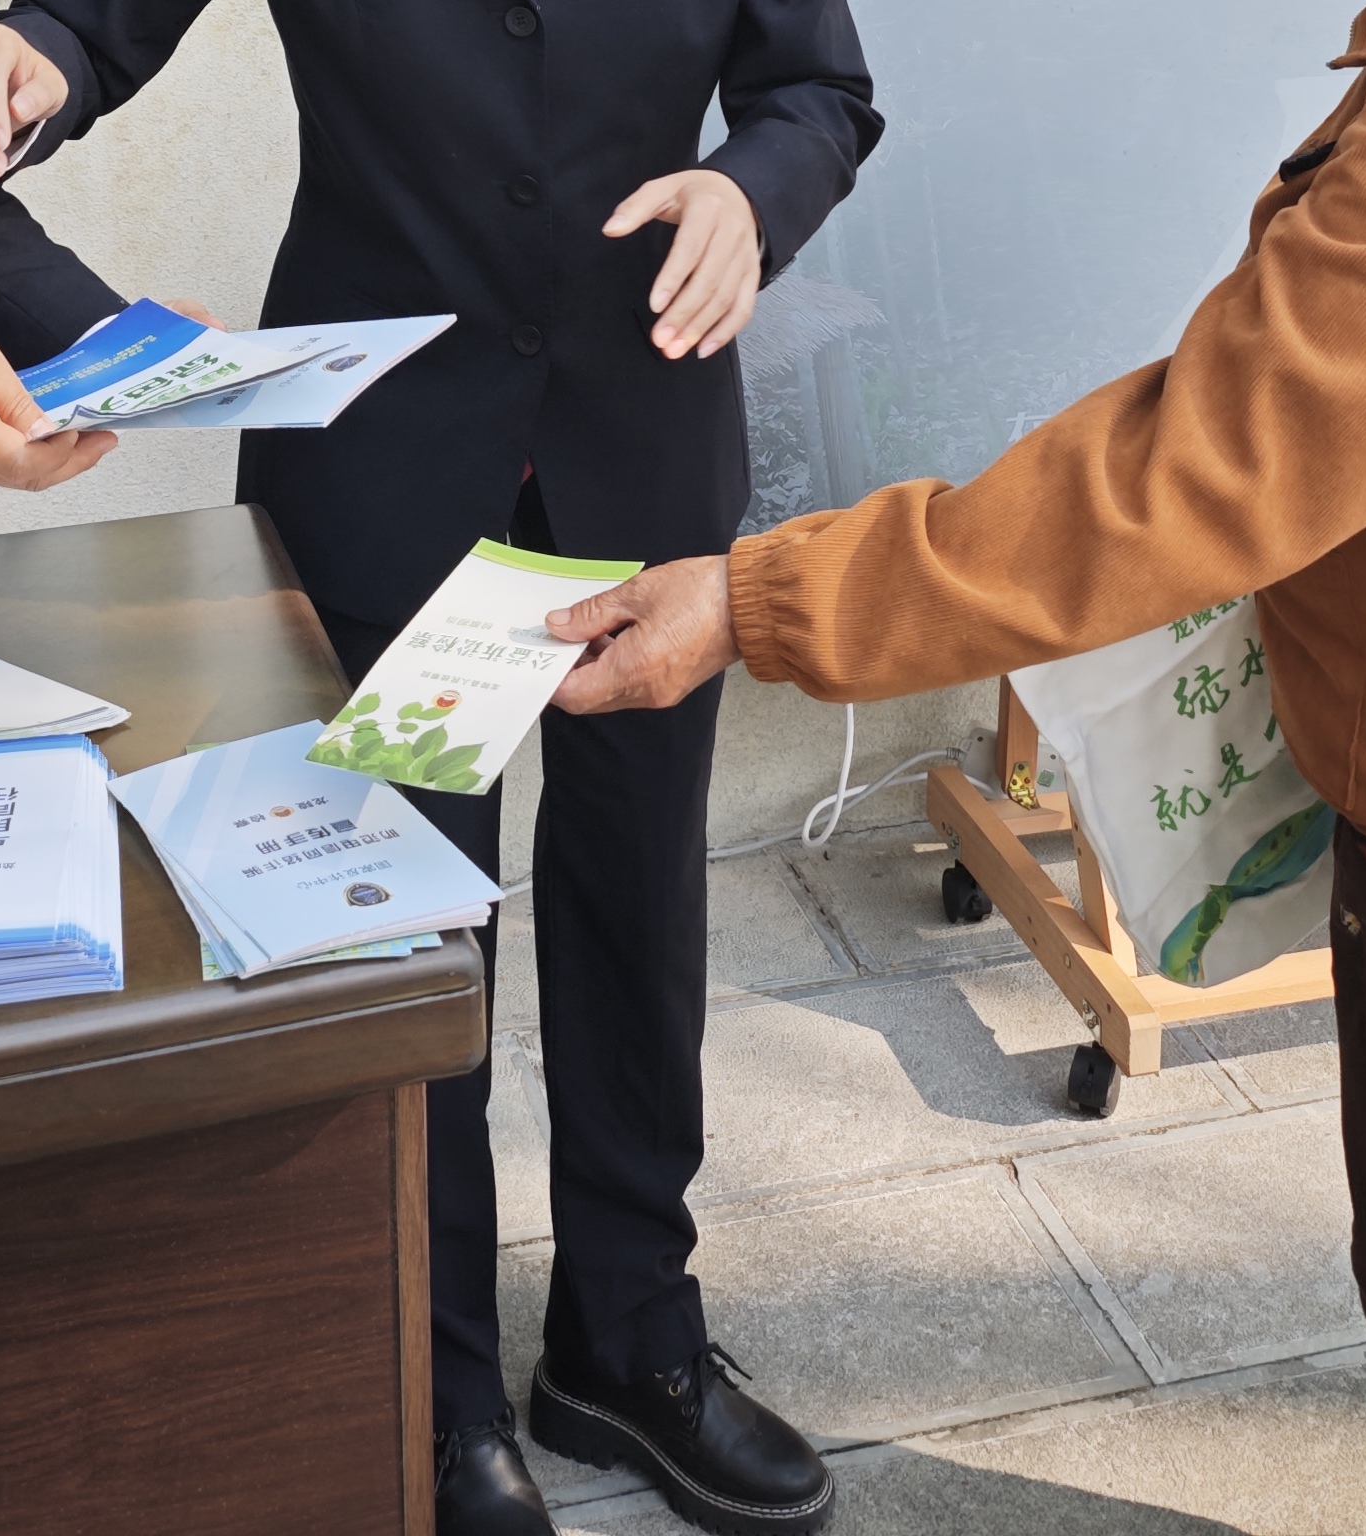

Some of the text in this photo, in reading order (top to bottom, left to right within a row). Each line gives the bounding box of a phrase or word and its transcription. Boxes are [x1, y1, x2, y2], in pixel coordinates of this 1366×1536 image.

[405, 631, 558, 671] 公益诉讼检察
[1149, 709, 1285, 831] 就是
[241, 828, 401, 879] 防范电信网络诈骗
[255, 818, 358, 855] 宣传手册
[296, 860, 393, 891] 国家反诈中心
